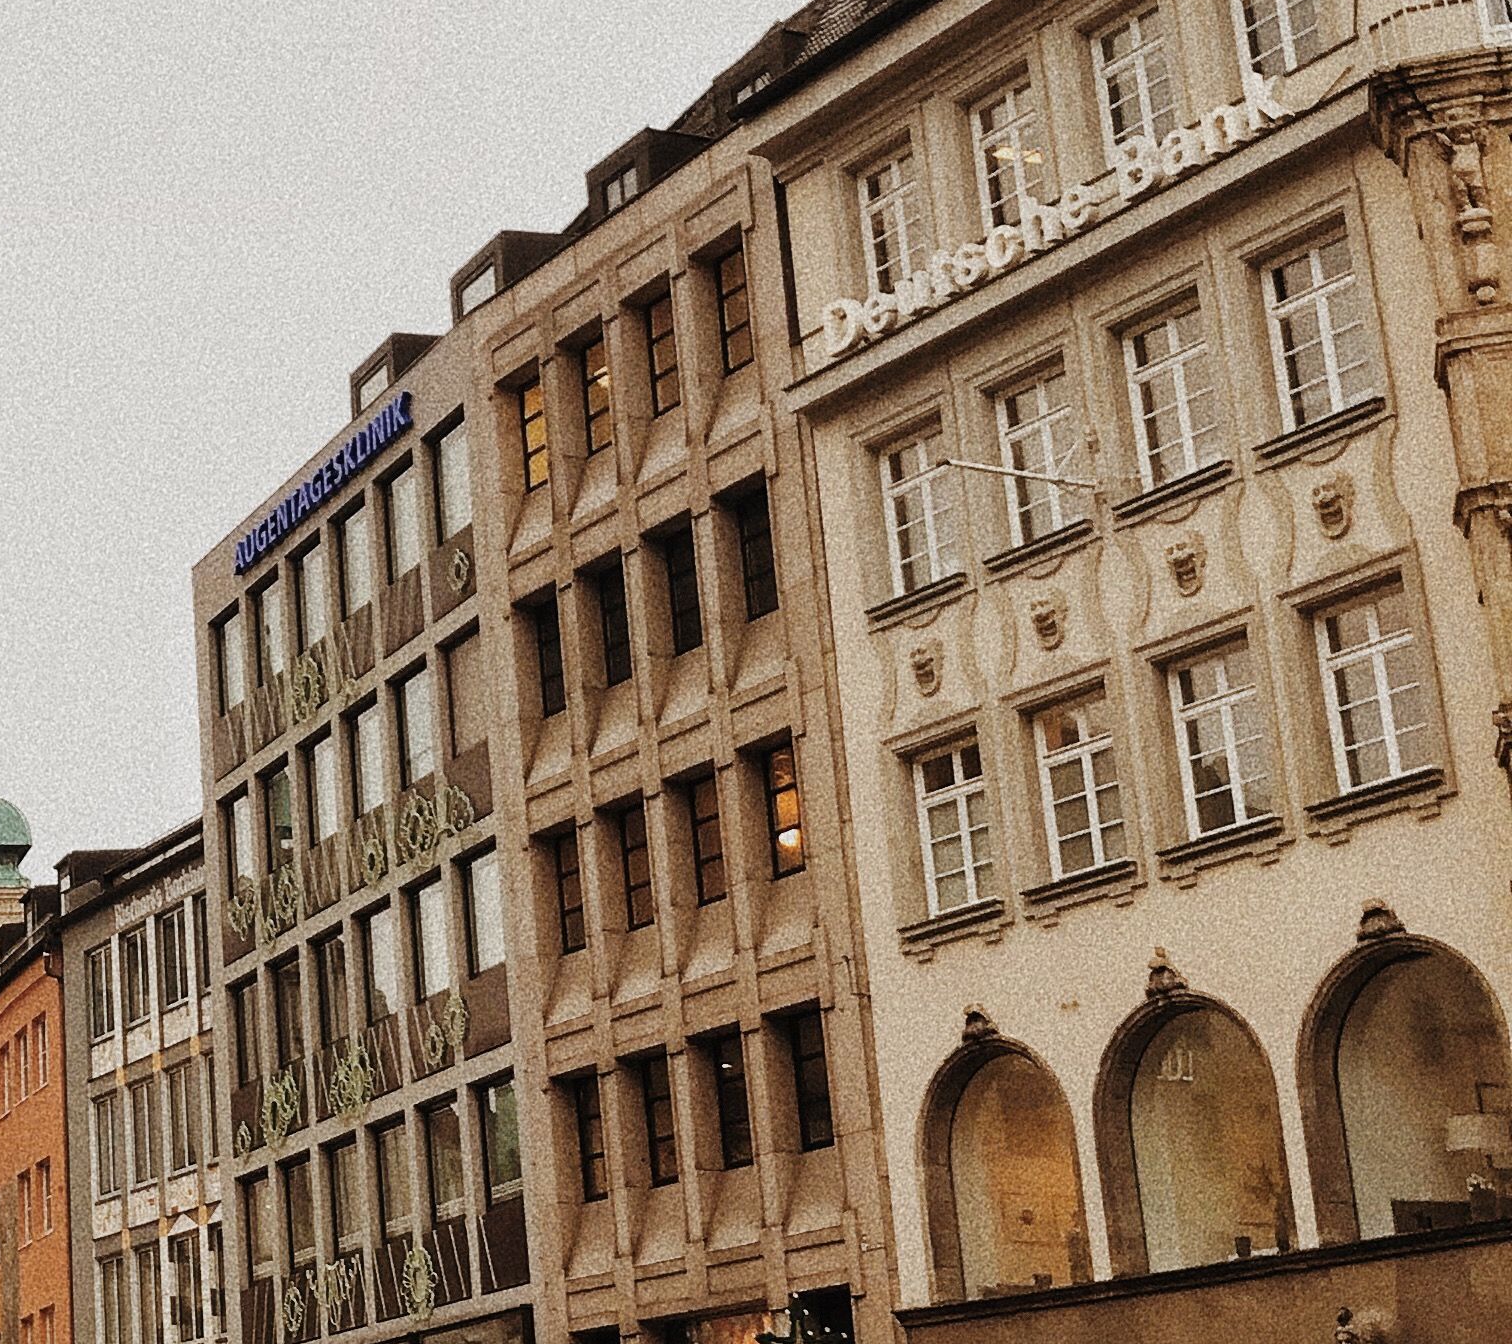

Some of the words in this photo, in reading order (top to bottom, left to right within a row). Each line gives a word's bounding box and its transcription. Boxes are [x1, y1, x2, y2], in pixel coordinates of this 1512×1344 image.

[821, 181, 1100, 358] Deutsche
[1114, 71, 1294, 204] Bank
[234, 391, 412, 574] AUGENTAGESKLINIK
